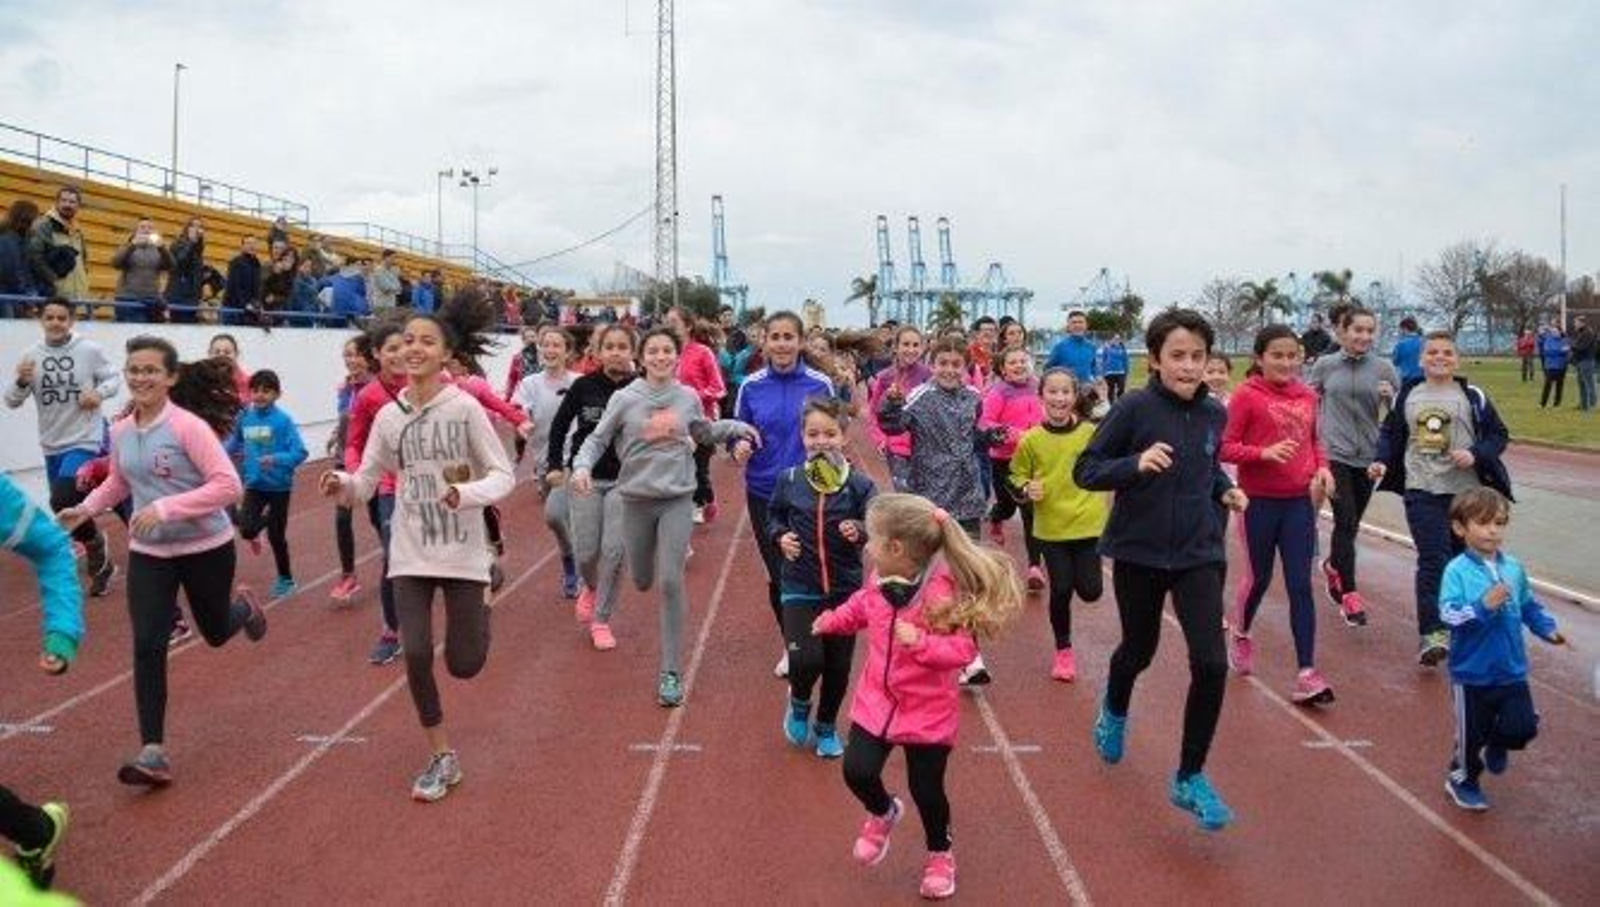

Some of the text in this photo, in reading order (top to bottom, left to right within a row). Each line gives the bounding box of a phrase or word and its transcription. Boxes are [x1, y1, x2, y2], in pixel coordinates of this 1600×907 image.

[42, 372, 79, 389] ALL
[403, 420, 470, 461] HEART
[420, 501, 468, 546] NYC
